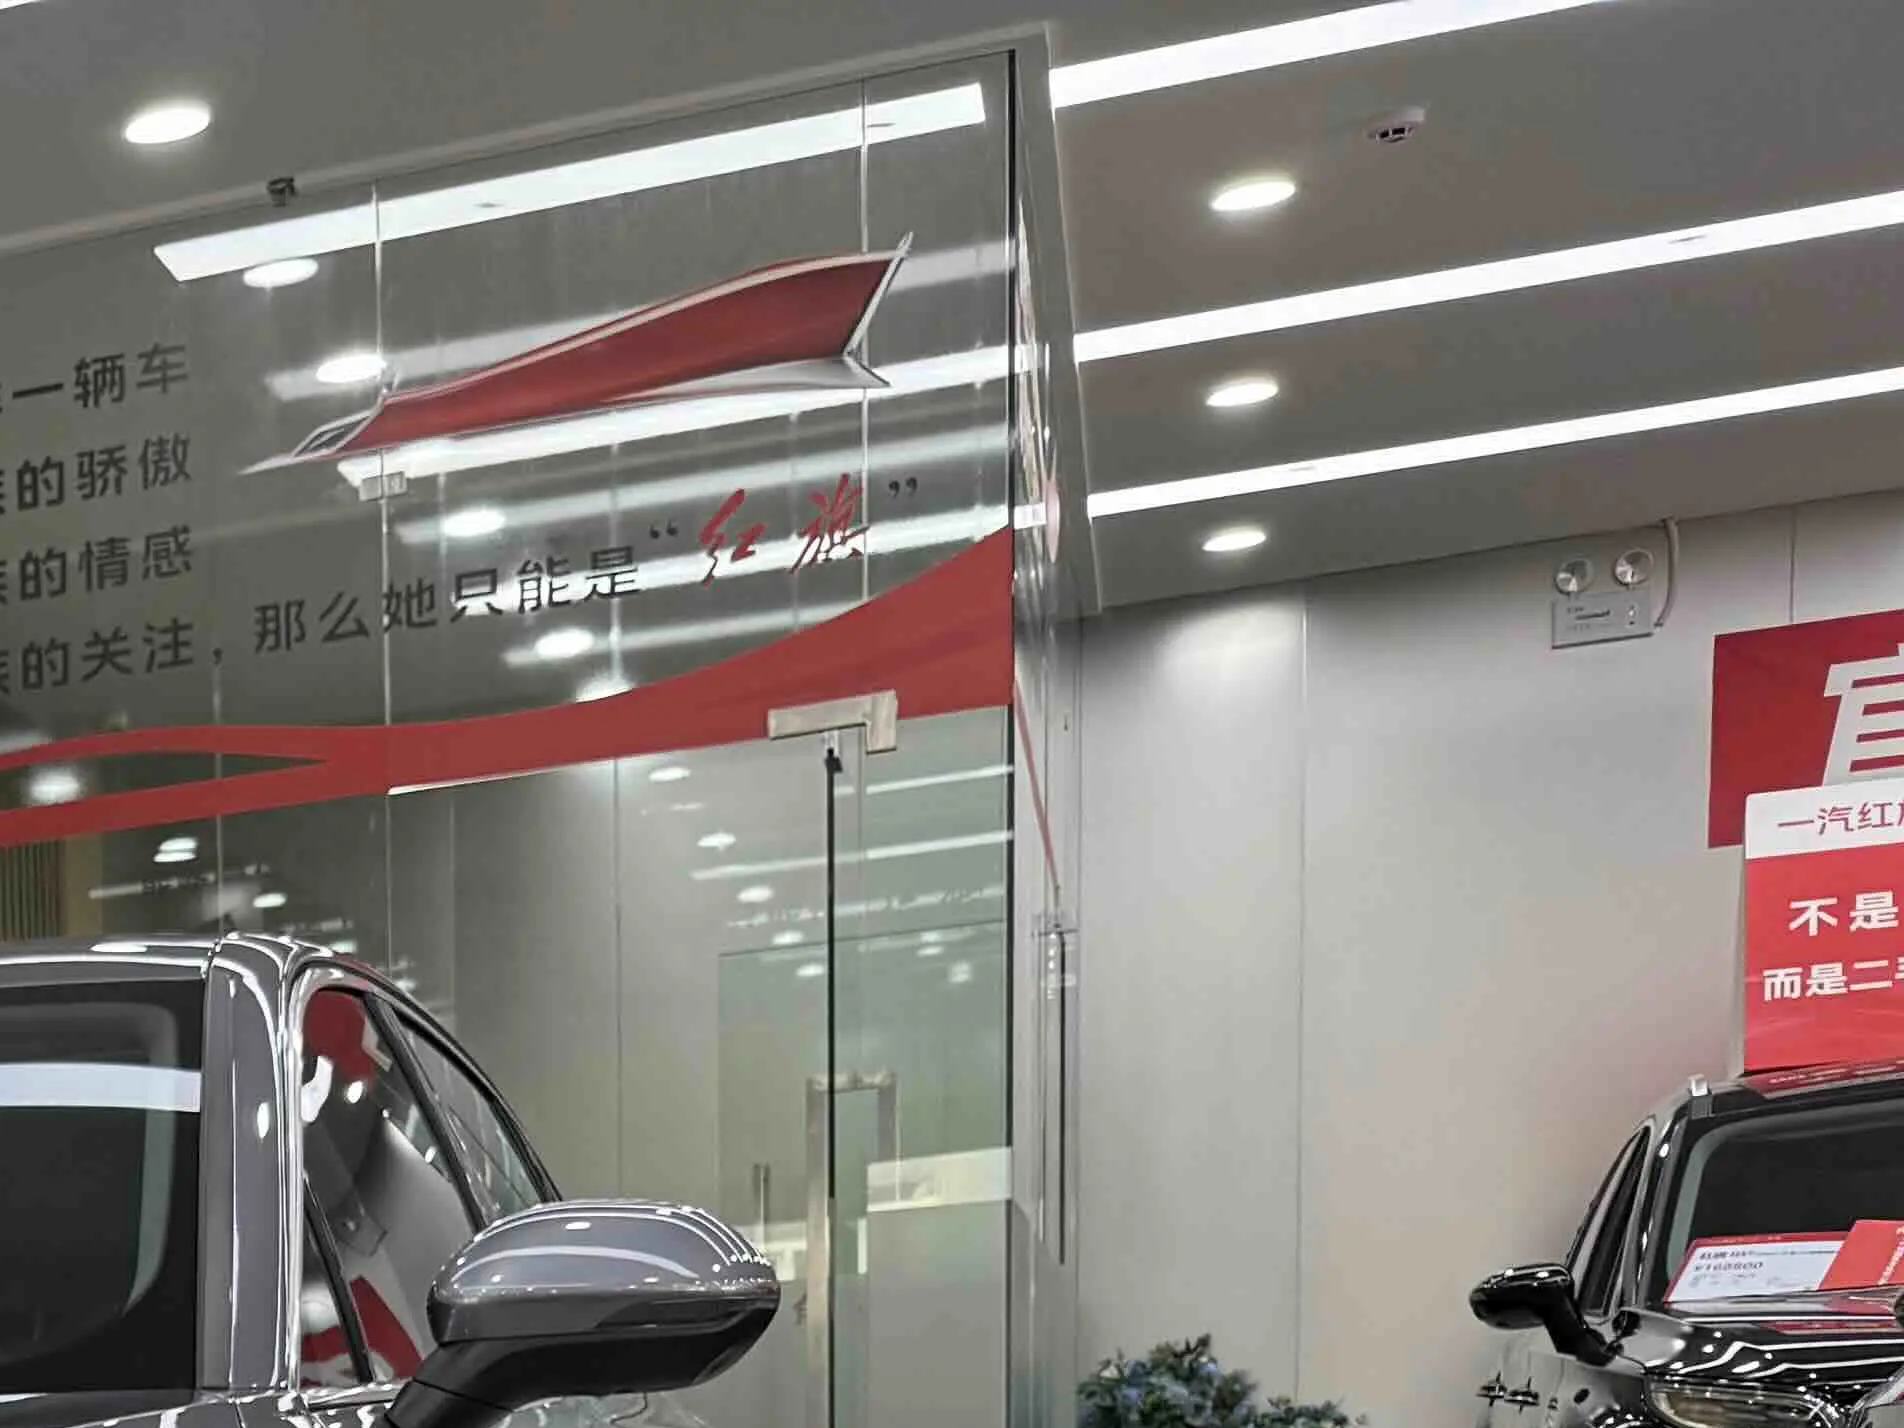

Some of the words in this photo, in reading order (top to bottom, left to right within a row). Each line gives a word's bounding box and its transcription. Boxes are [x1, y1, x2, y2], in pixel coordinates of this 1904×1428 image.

[1778, 802, 1904, 836] 一汽红
[1789, 891, 1899, 937] 不是
[1763, 956, 1904, 1001] 而是二
